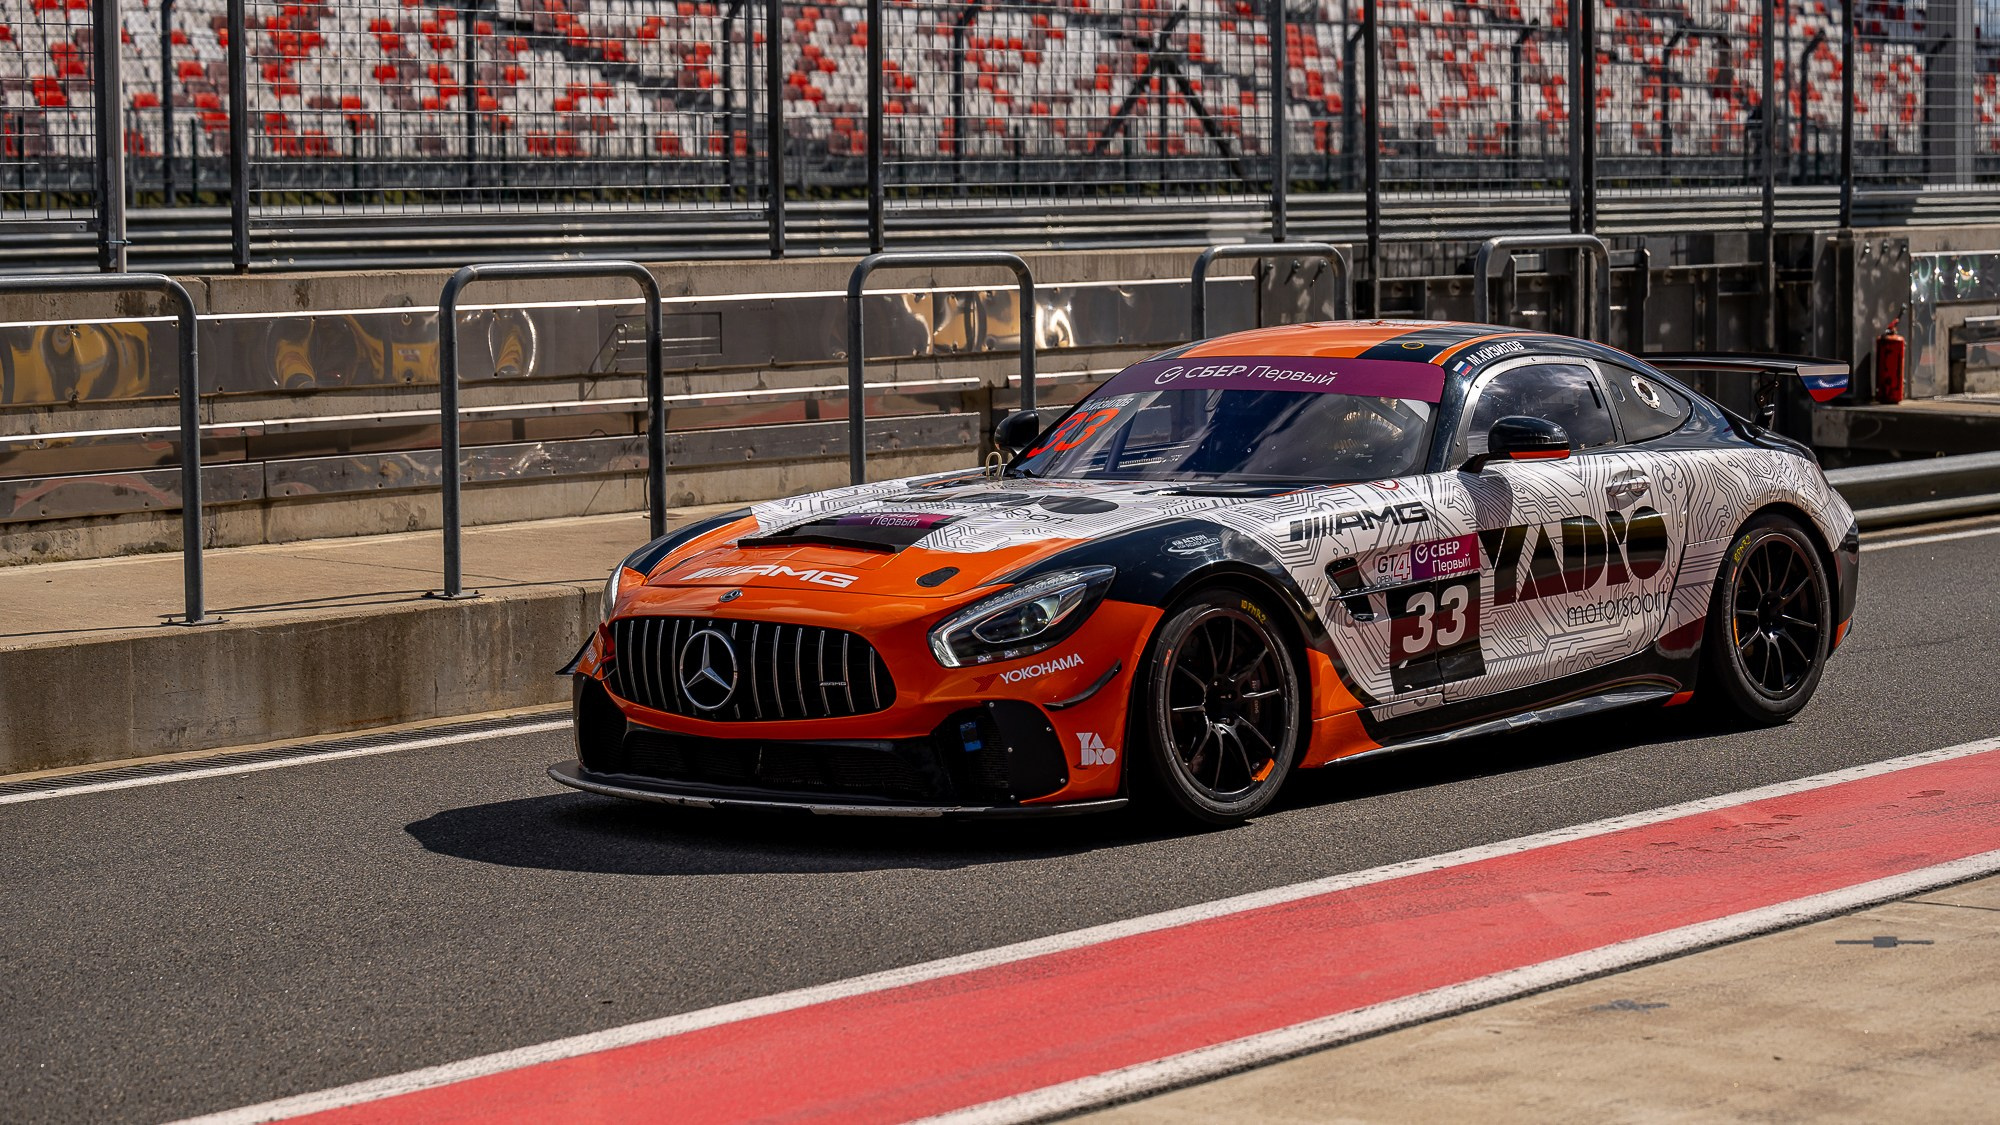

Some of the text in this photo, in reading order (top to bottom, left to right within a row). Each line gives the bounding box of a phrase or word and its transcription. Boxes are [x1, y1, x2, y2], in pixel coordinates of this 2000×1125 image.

[1184, 365, 1338, 386] СБЕР Первый
[1026, 408, 1120, 458] 33
[870, 516, 922, 527] Первый
[1336, 501, 1430, 536] AMG
[1430, 541, 1460, 557] СБЕР
[742, 564, 860, 588] AMG
[1377, 552, 1411, 580] GT4
[1432, 553, 1471, 574] Первый
[1376, 575, 1393, 585] OPEN
[1402, 584, 1469, 653] 33
[1567, 584, 1668, 628] motorsport
[1000, 653, 1084, 684] YOKOHAMA
